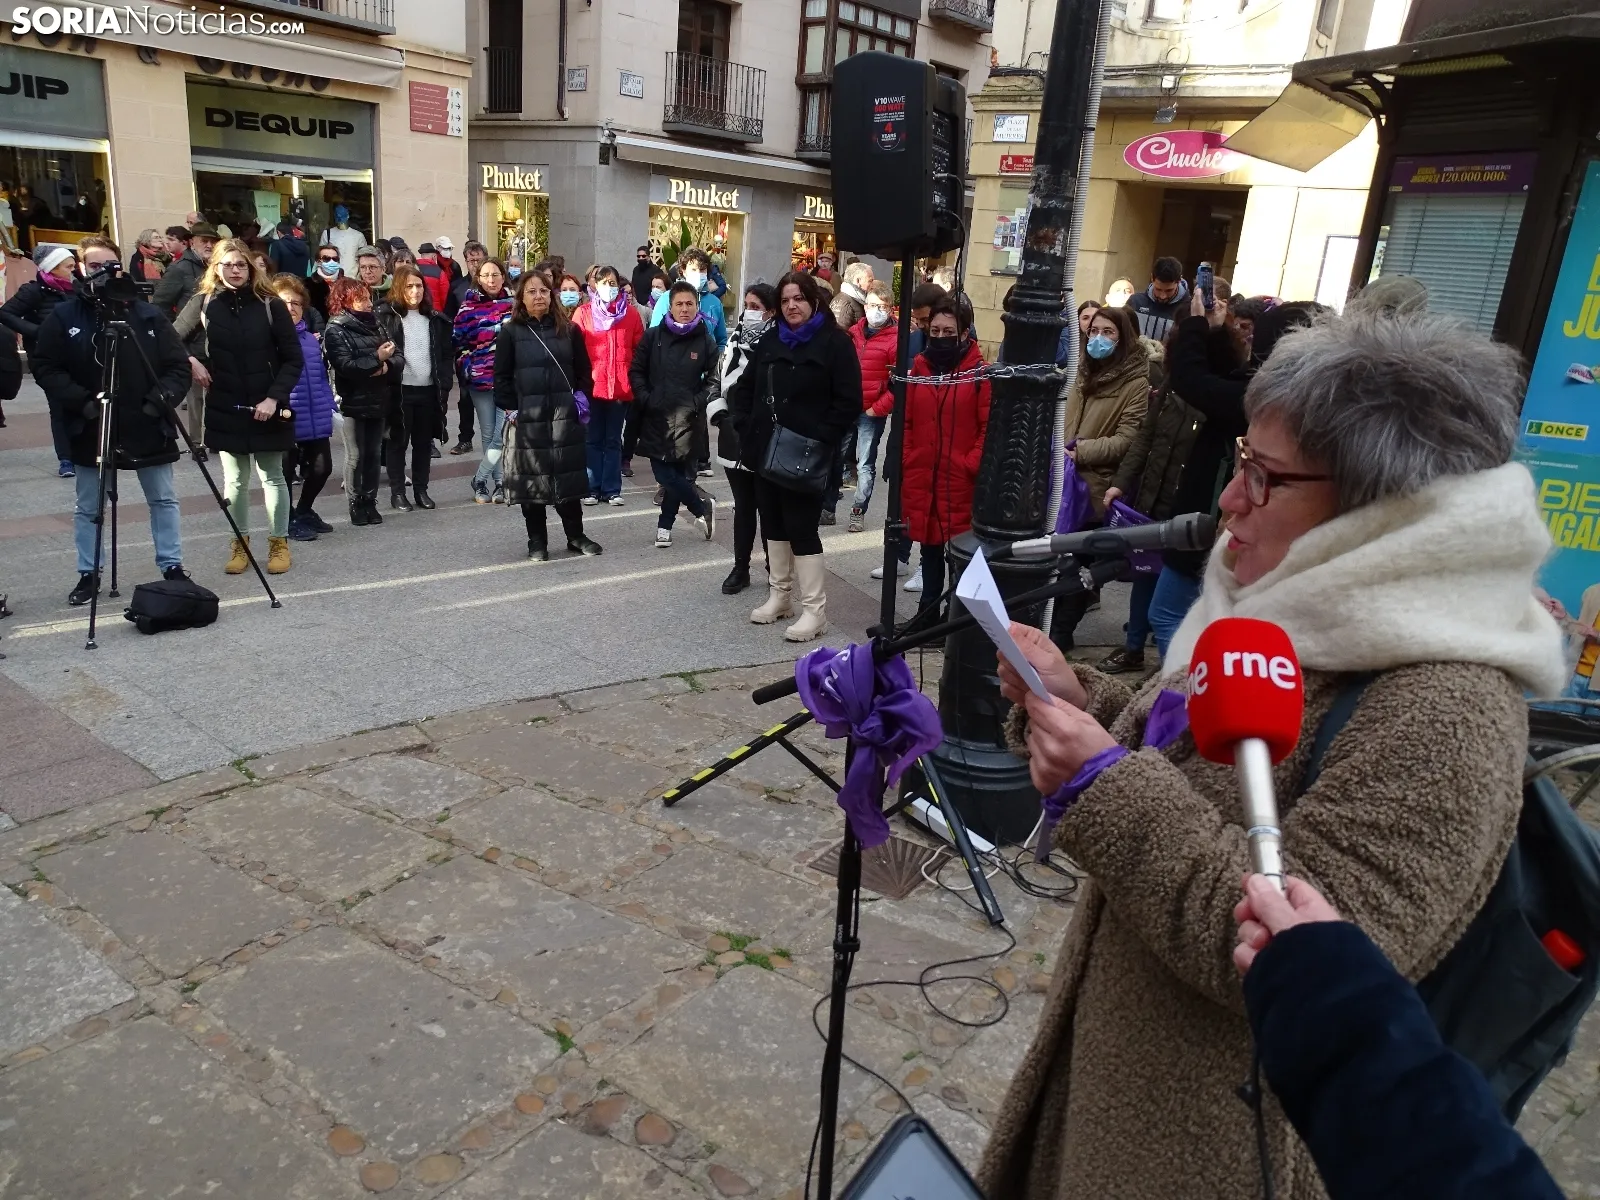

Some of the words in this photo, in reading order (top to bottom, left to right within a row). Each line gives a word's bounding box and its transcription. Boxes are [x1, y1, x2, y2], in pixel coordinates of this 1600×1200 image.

[205, 107, 354, 139] DEQUIP
[482, 164, 541, 191] Phuket
[667, 178, 740, 209] Phuket
[803, 195, 834, 220] Phu
[1544, 424, 1585, 437] ONCE
[1222, 651, 1296, 690] rne
